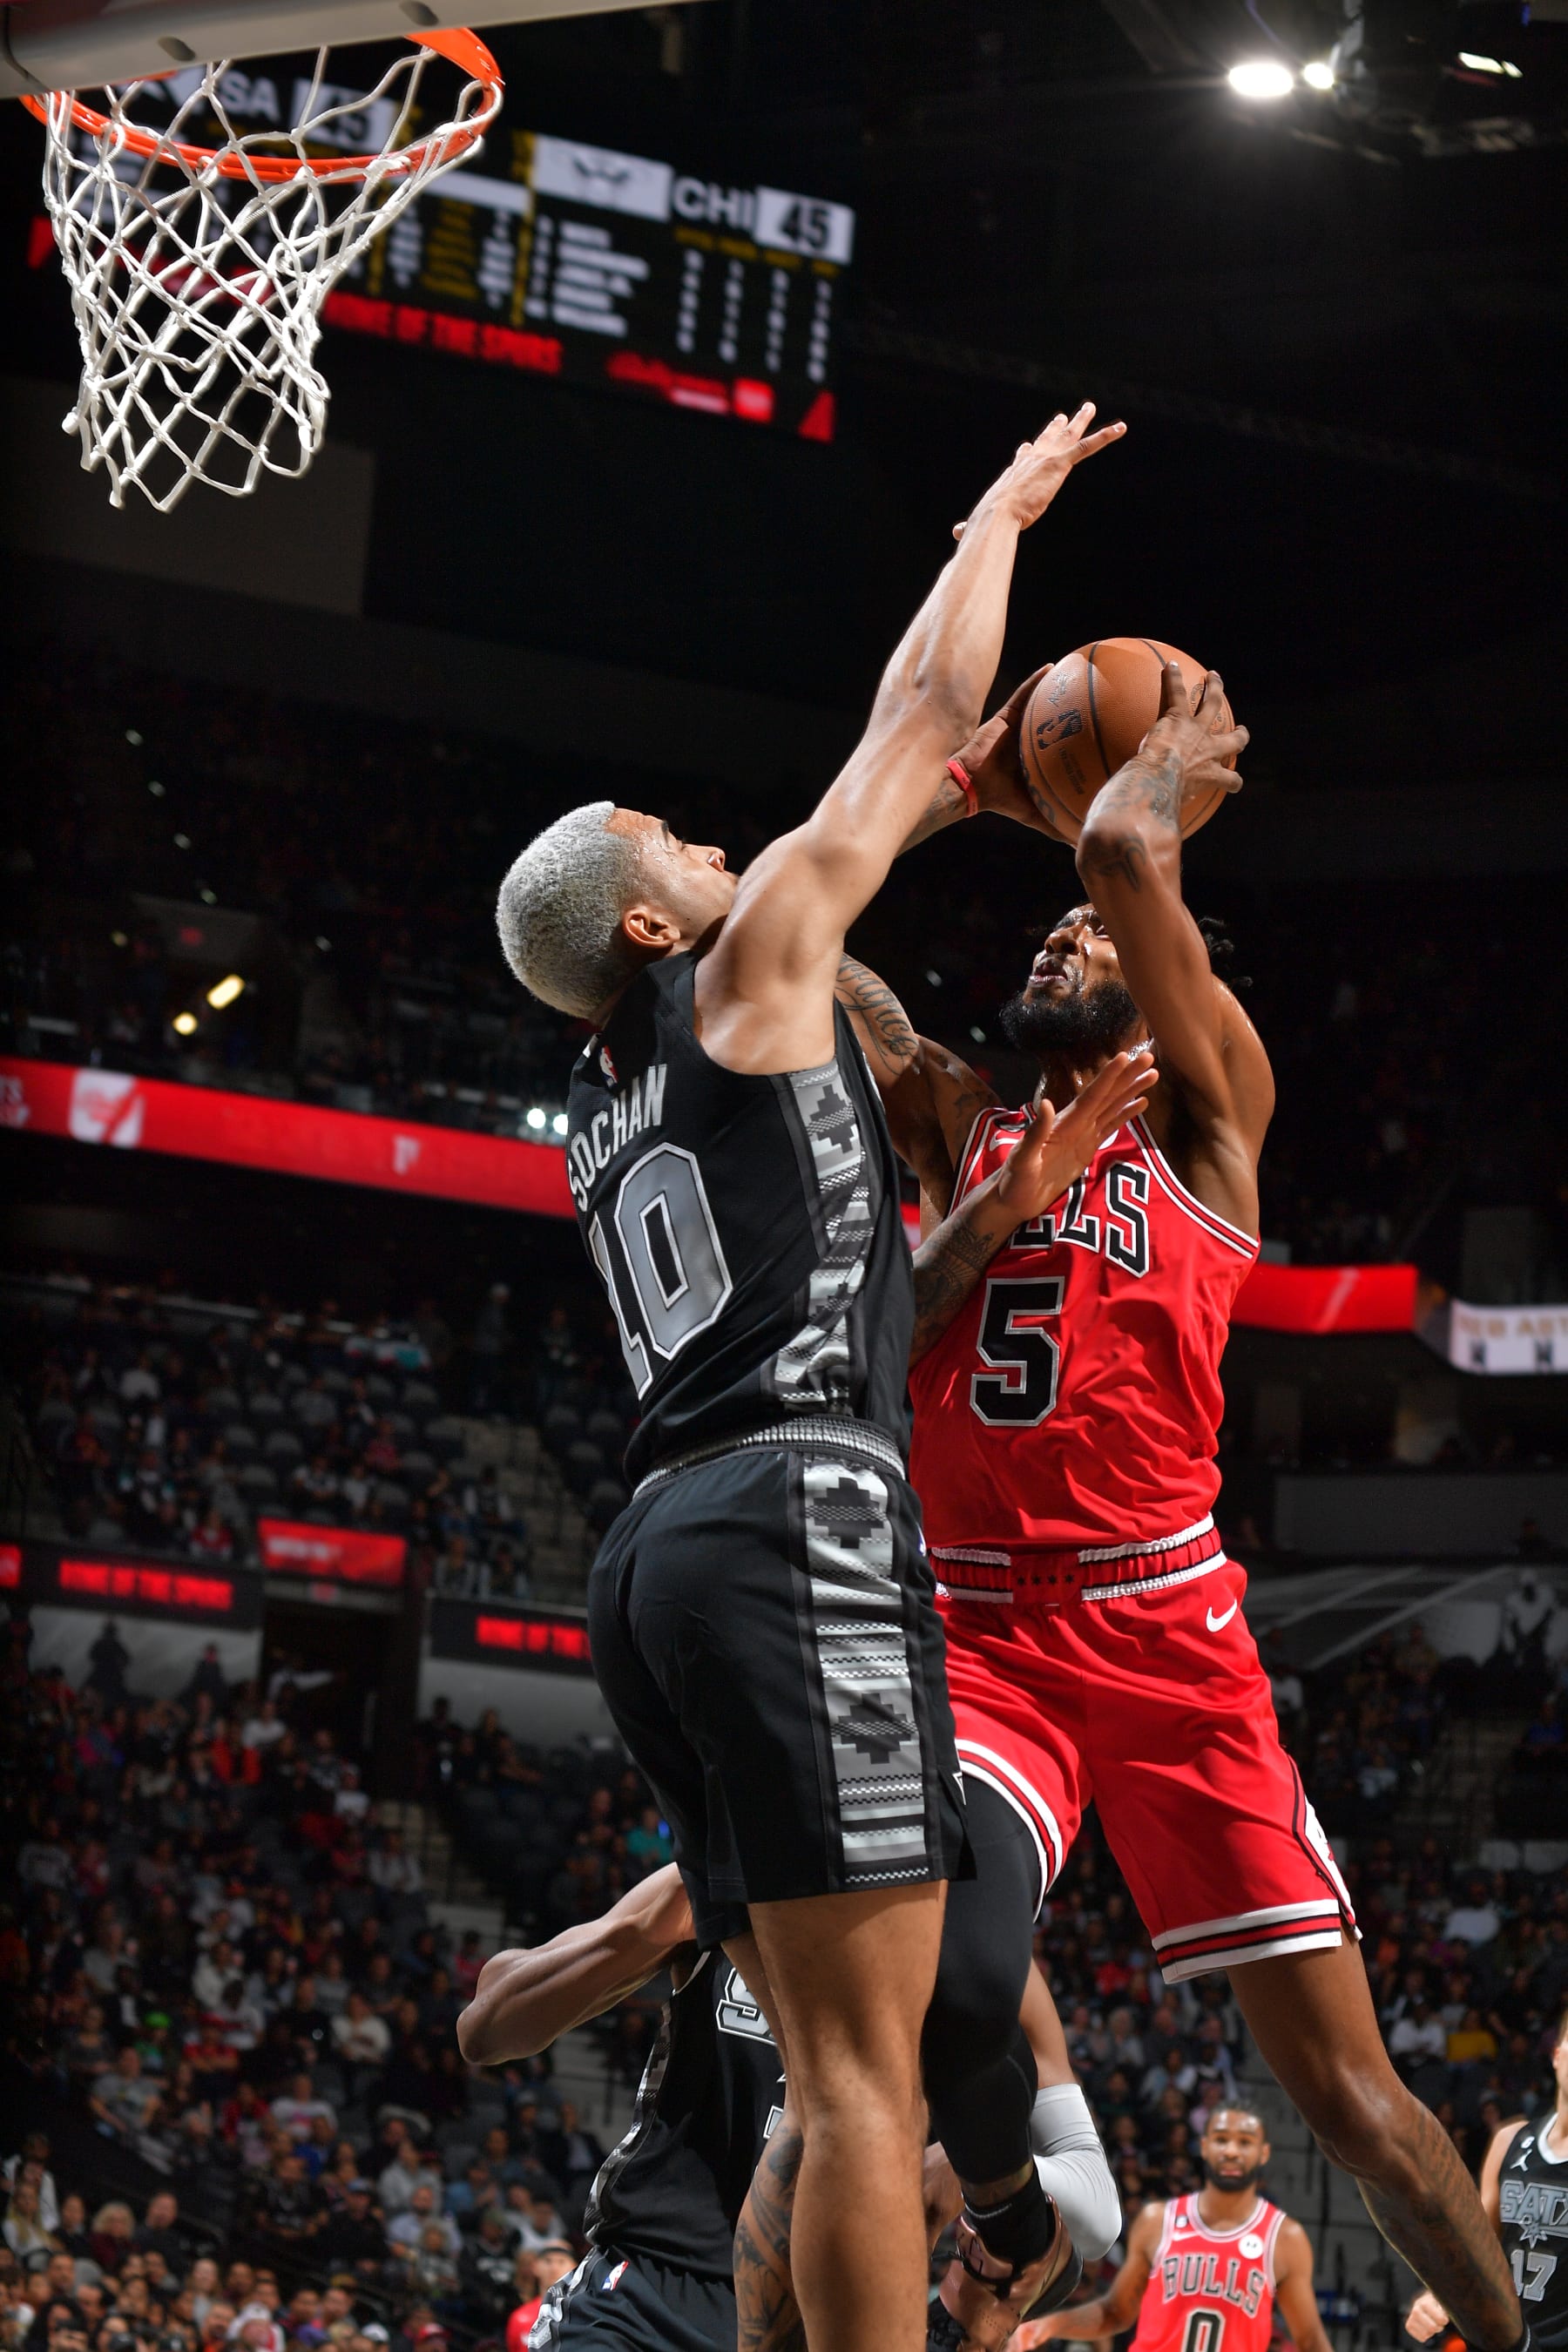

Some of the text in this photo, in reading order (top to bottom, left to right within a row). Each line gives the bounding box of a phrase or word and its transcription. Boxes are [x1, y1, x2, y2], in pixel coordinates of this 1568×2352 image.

[673, 177, 754, 232] CHI
[781, 201, 830, 251] 45
[568, 1064, 667, 1212] SOCHAN
[588, 1141, 733, 1401] 10
[970, 1276, 1065, 1426] 5
[1162, 2254, 1266, 2319] BULLS
[1511, 2249, 1558, 2301] 17
[1181, 2307, 1226, 2352] 0
